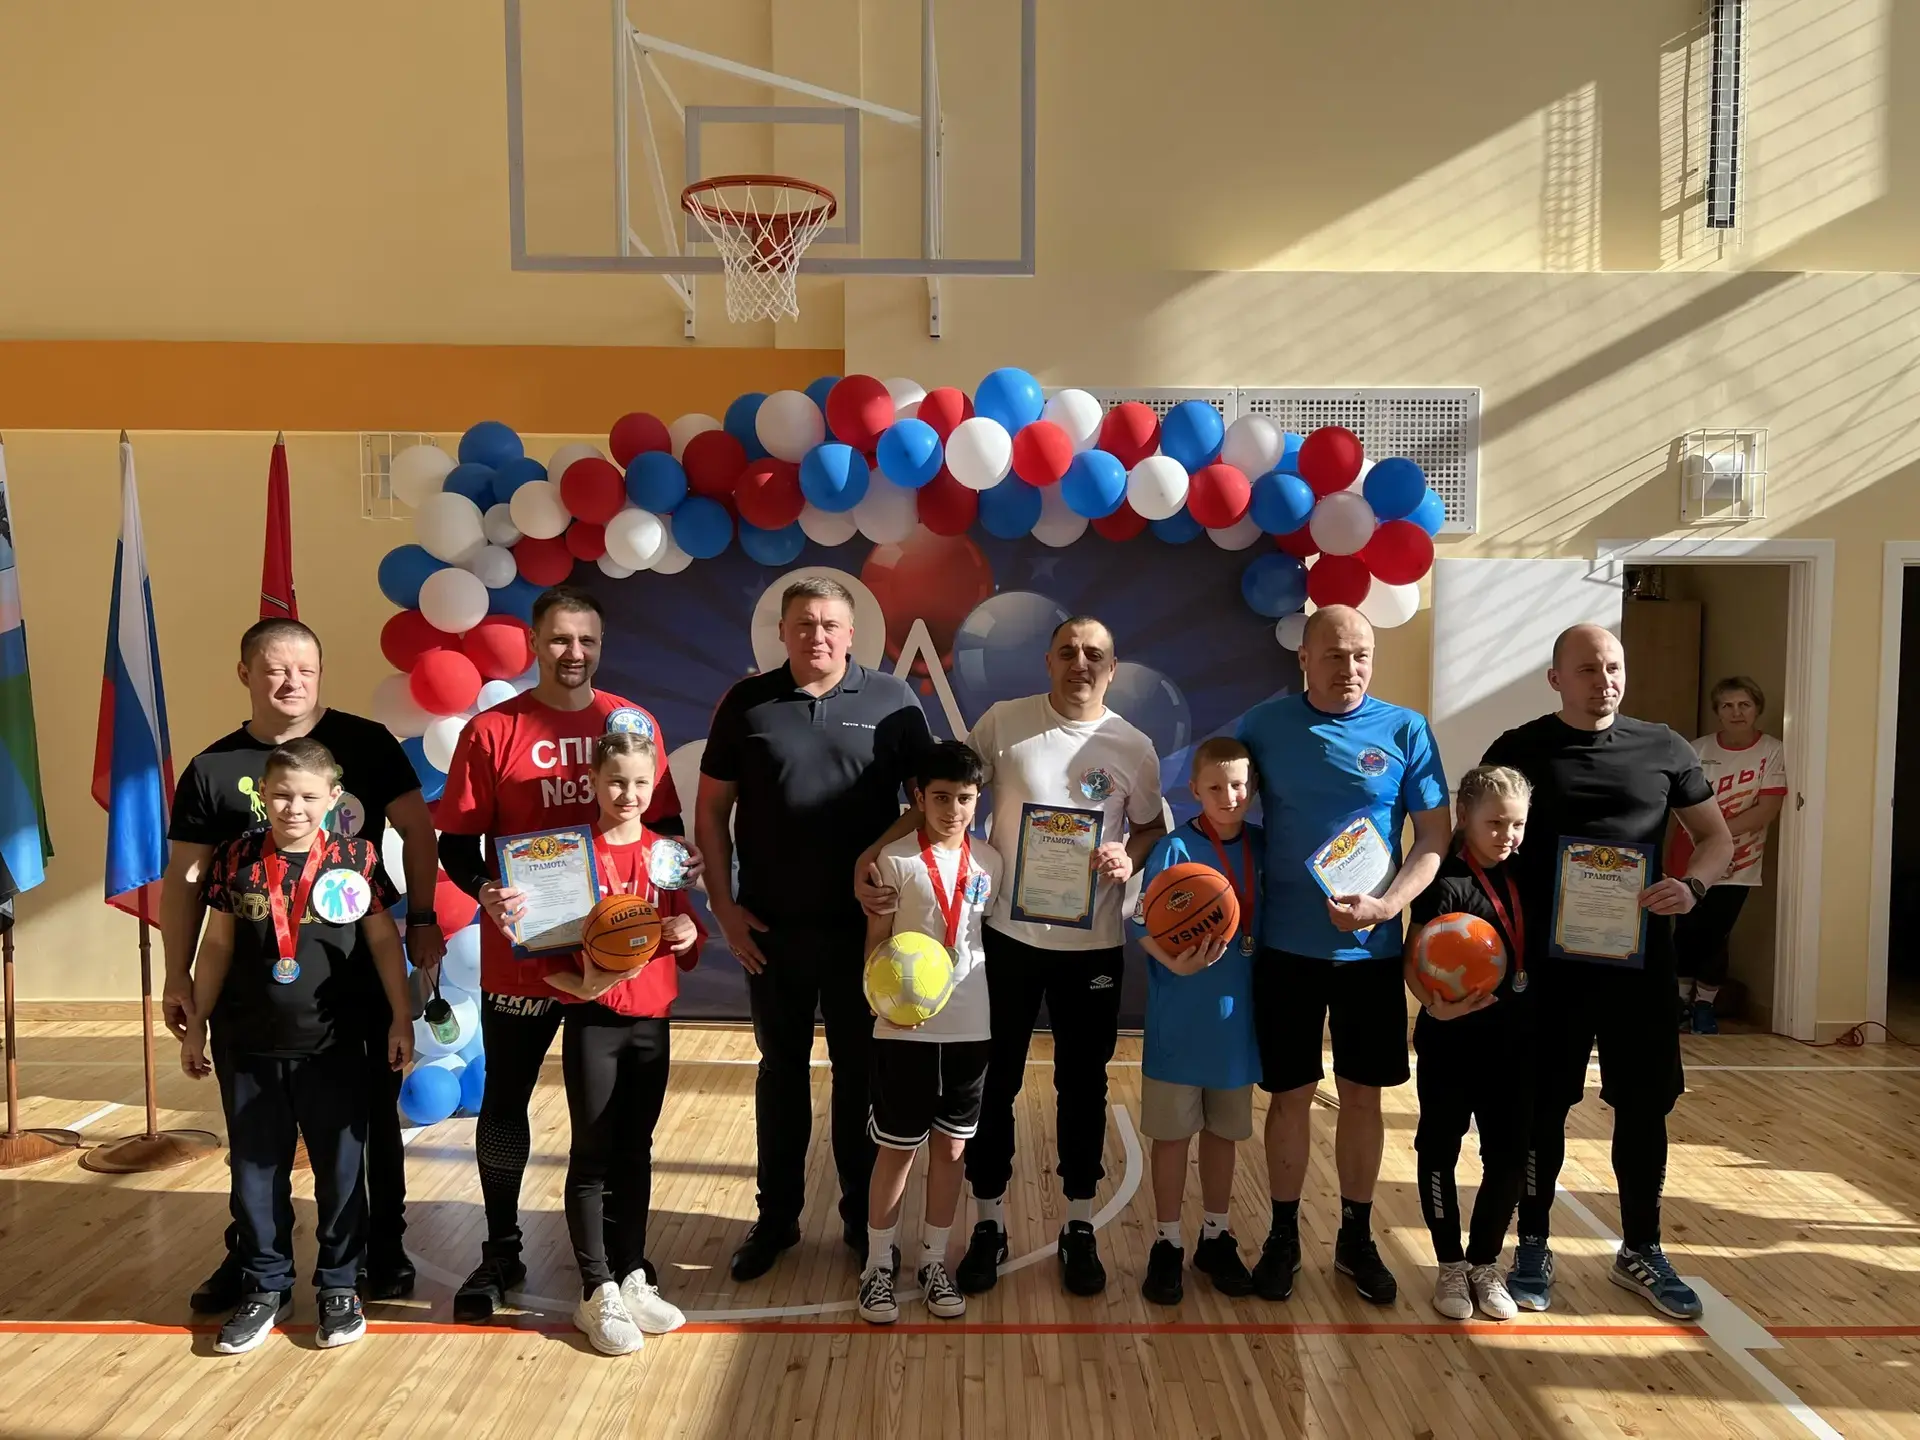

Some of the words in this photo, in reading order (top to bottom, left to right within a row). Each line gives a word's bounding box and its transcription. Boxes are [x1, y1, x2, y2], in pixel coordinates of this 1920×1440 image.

[1042, 835, 1076, 846] ГРАМОТА
[1337, 845, 1366, 871] ГРАМОТА
[529, 860, 568, 872] ГРАМОТА
[1584, 871, 1623, 883] ГРАМОТА
[1168, 905, 1225, 945] MINSA
